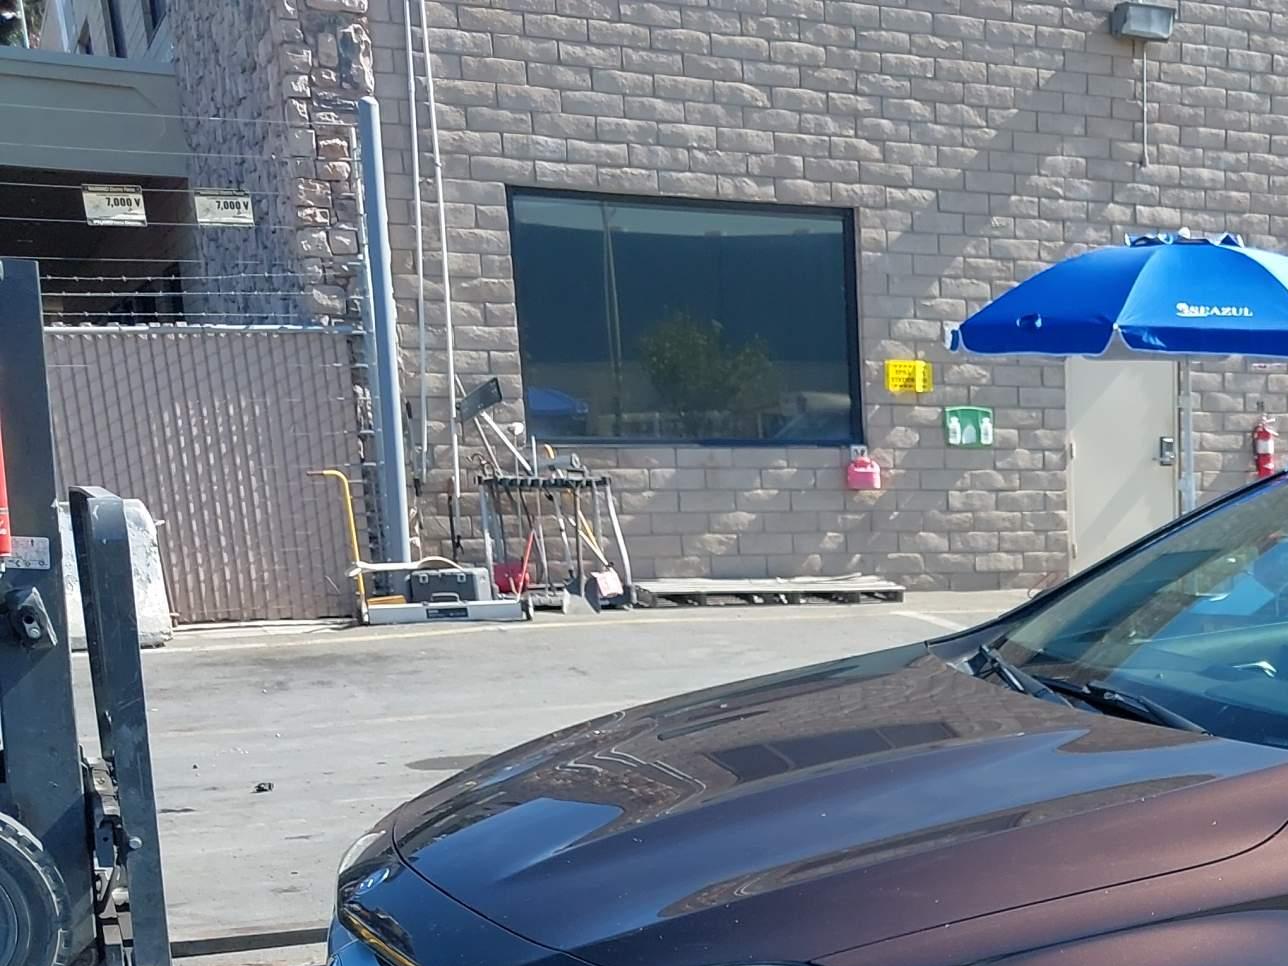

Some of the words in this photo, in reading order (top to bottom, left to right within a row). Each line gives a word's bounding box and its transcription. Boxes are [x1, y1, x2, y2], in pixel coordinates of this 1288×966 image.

[105, 197, 133, 208] 7,000
[133, 197, 141, 207] V
[215, 200, 241, 211] 7,000
[242, 200, 250, 211] V
